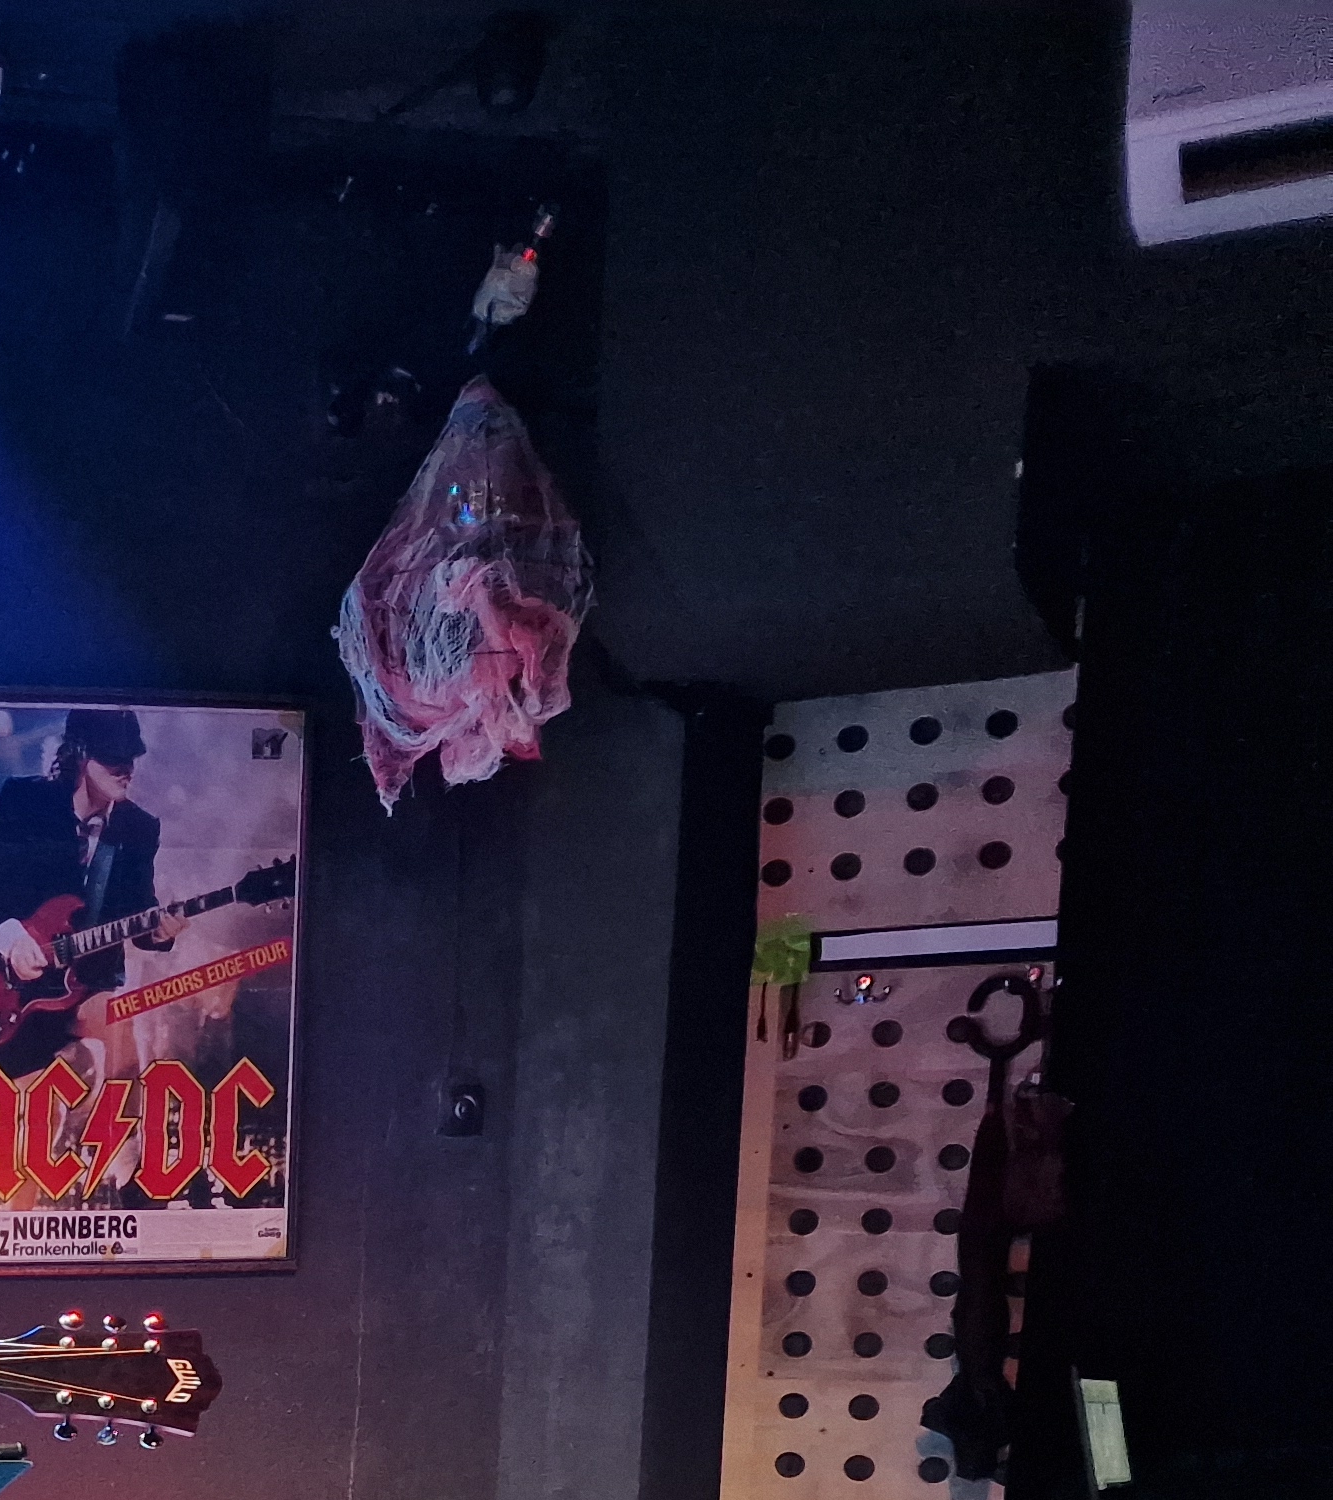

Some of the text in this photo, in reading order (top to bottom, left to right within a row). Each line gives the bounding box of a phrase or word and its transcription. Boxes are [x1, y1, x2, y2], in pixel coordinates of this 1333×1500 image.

[110, 940, 288, 1018] THE RAZORS EDGE TOUR
[13, 1214, 137, 1241] NÜRNBERG
[12, 1241, 107, 1257] Frankenhalle
